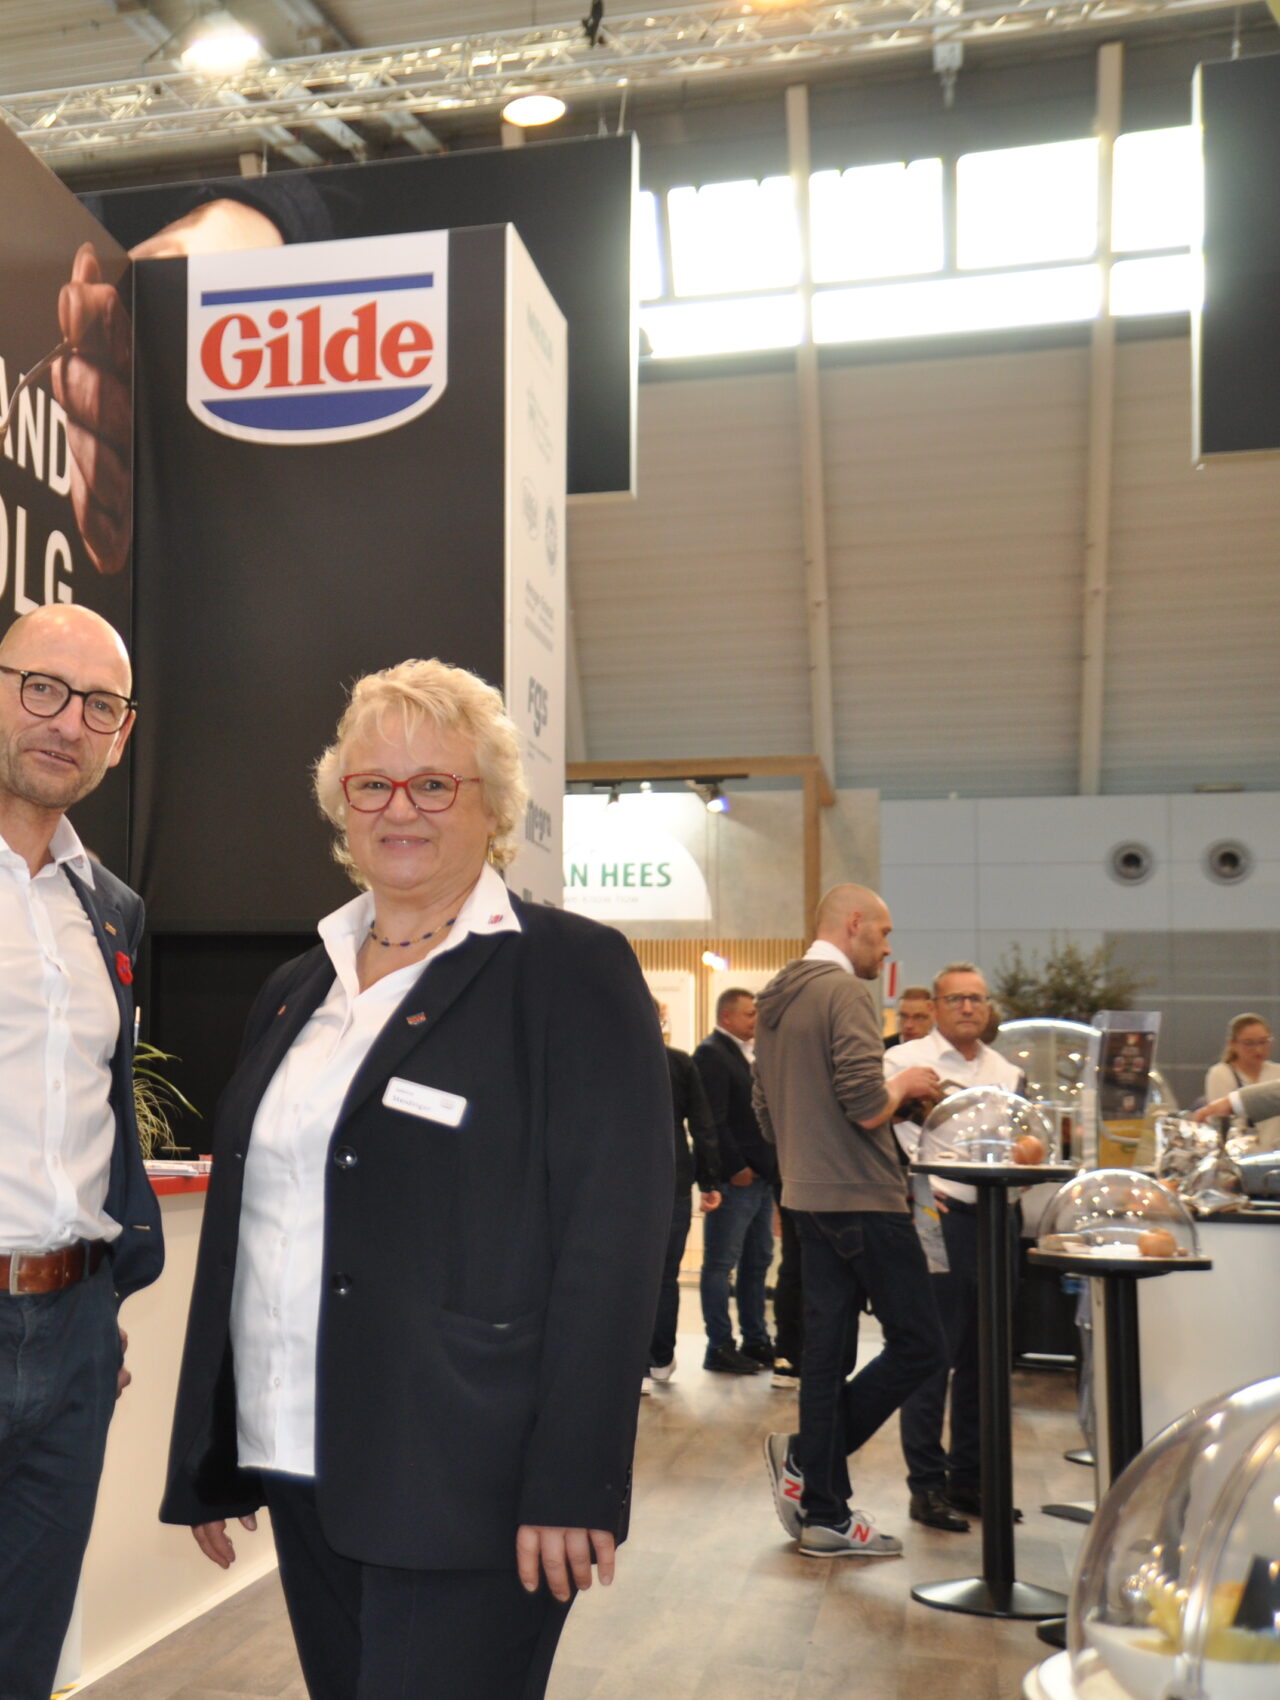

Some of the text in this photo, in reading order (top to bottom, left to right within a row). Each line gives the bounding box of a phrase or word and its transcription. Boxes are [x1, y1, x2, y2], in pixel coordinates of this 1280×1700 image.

[200, 300, 434, 391] Gilde
[563, 862, 672, 888] N HEES
[852, 1522, 871, 1543] N
